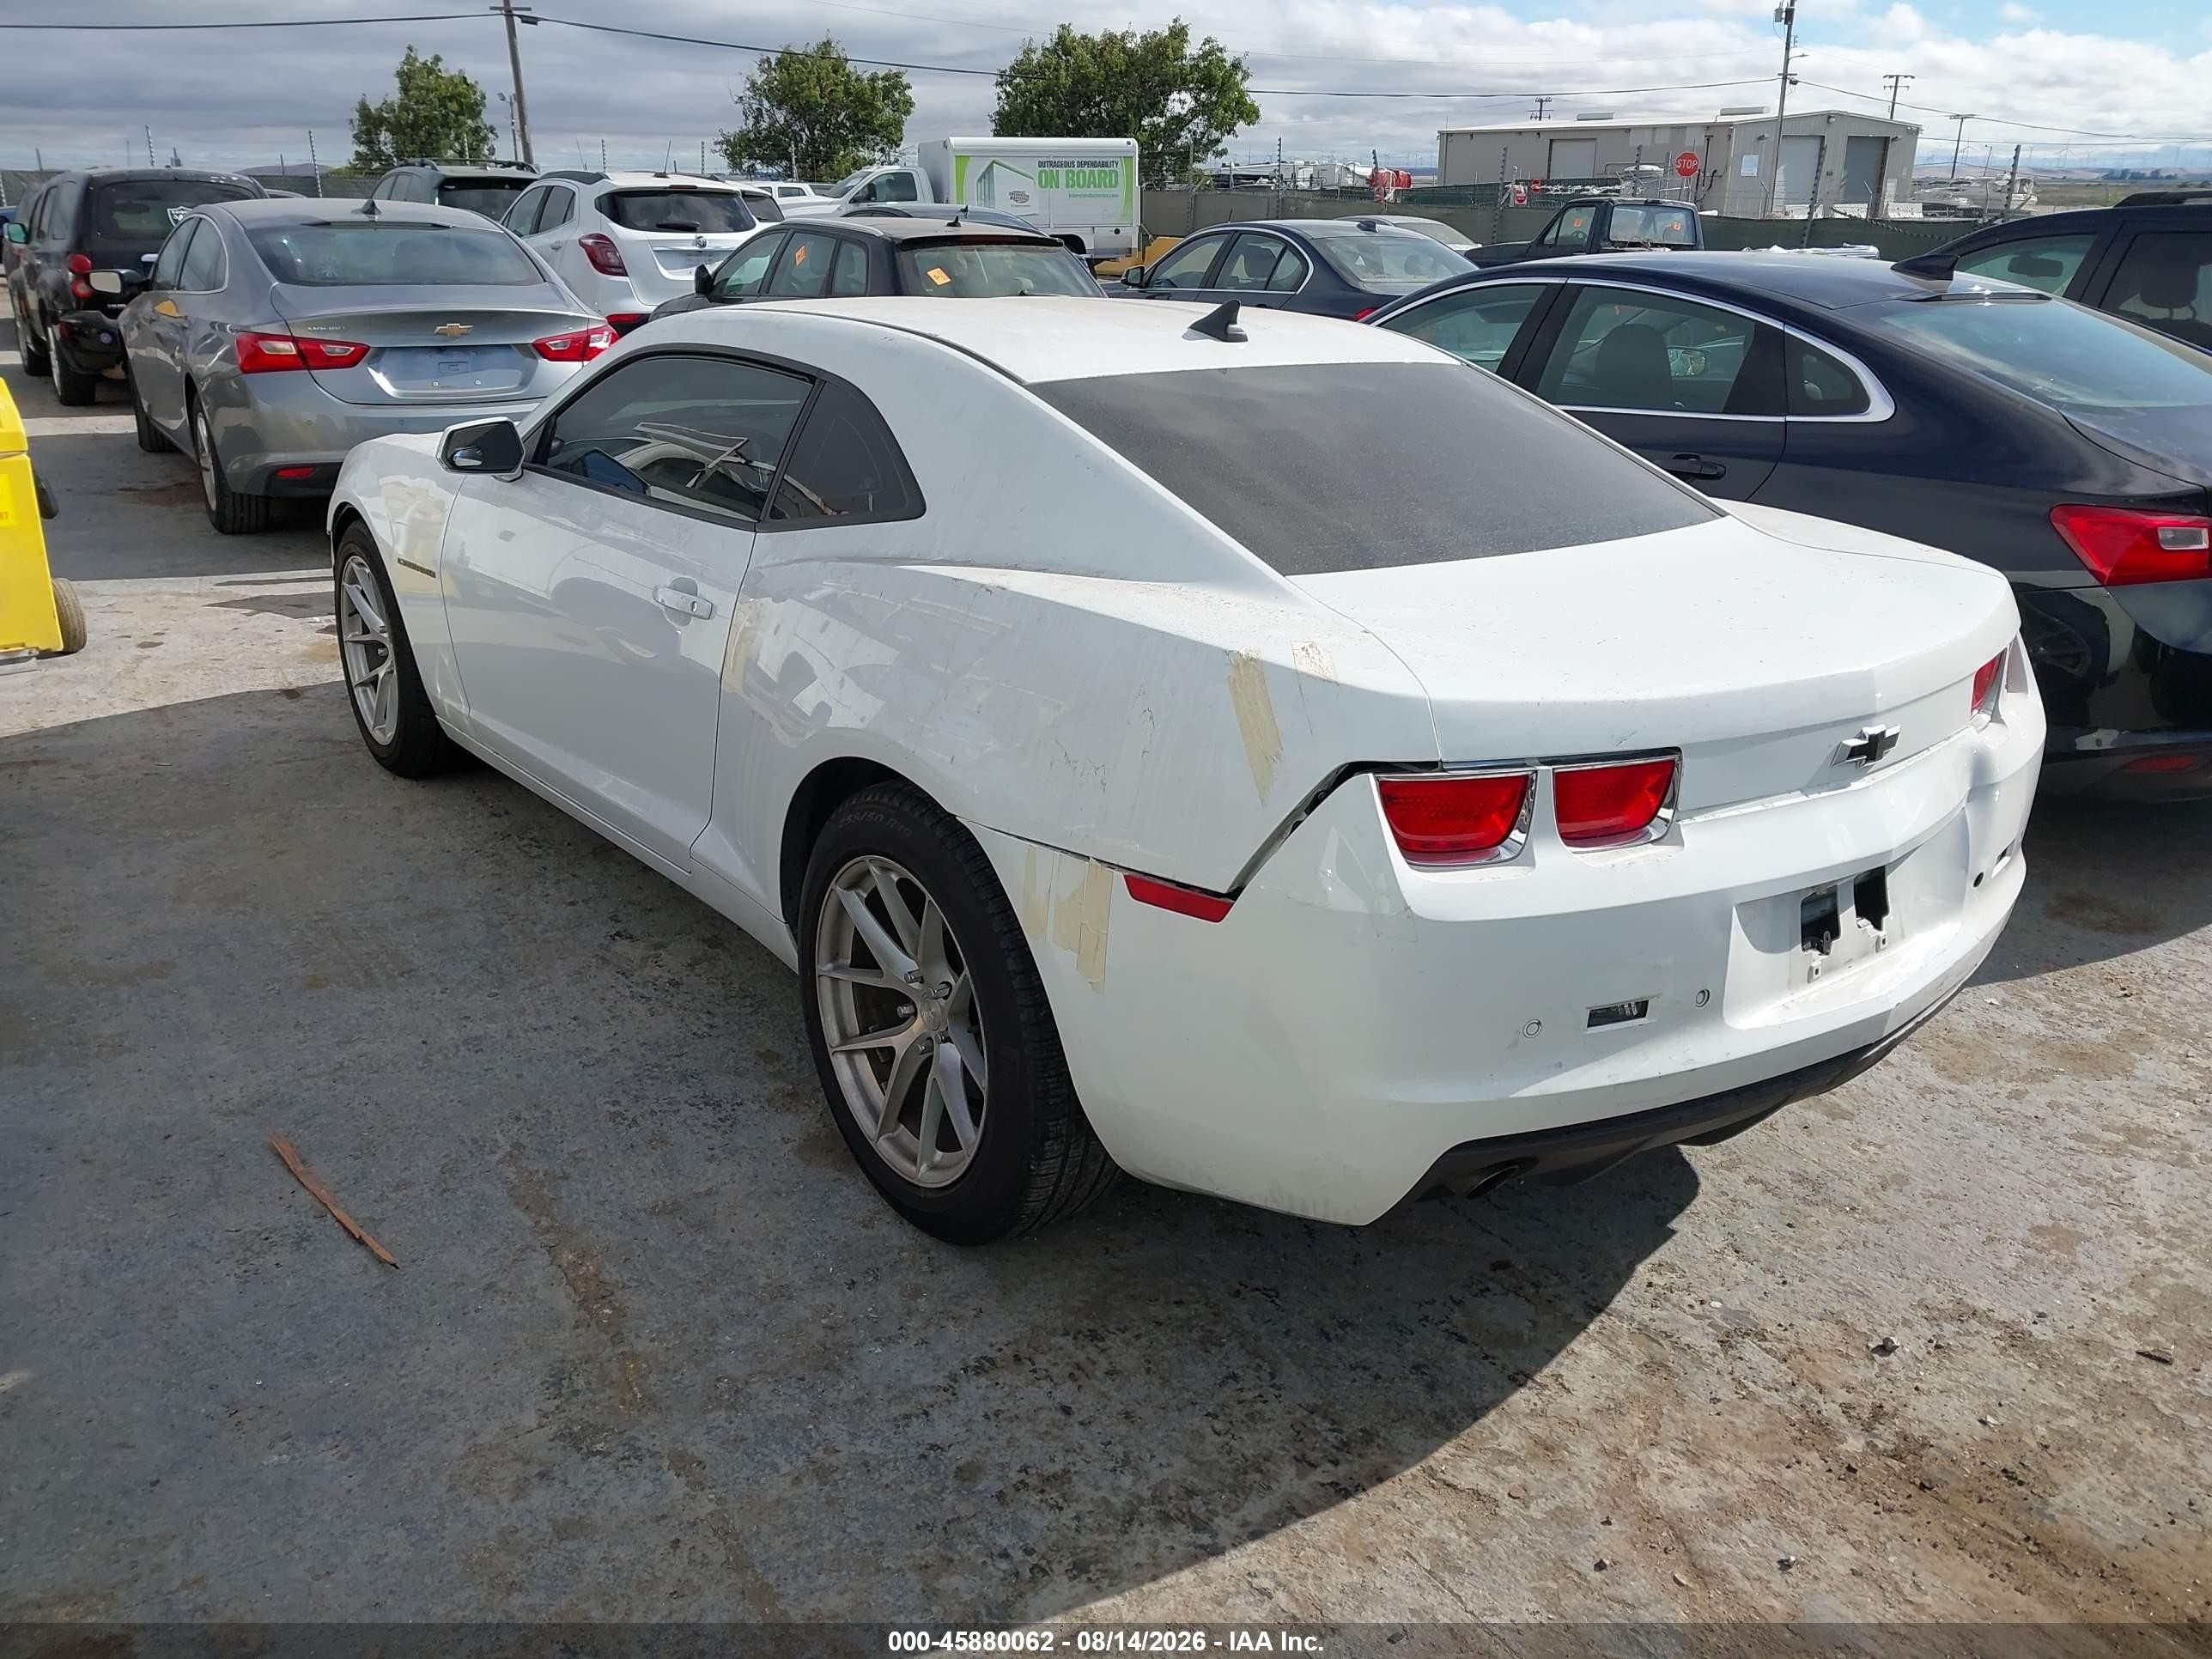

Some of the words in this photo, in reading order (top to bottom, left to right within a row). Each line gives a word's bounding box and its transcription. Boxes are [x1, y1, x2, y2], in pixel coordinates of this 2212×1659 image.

[1676, 159, 1698, 169] STOP
[1037, 169, 1060, 189] ON
[1065, 169, 1119, 189] BOARD
